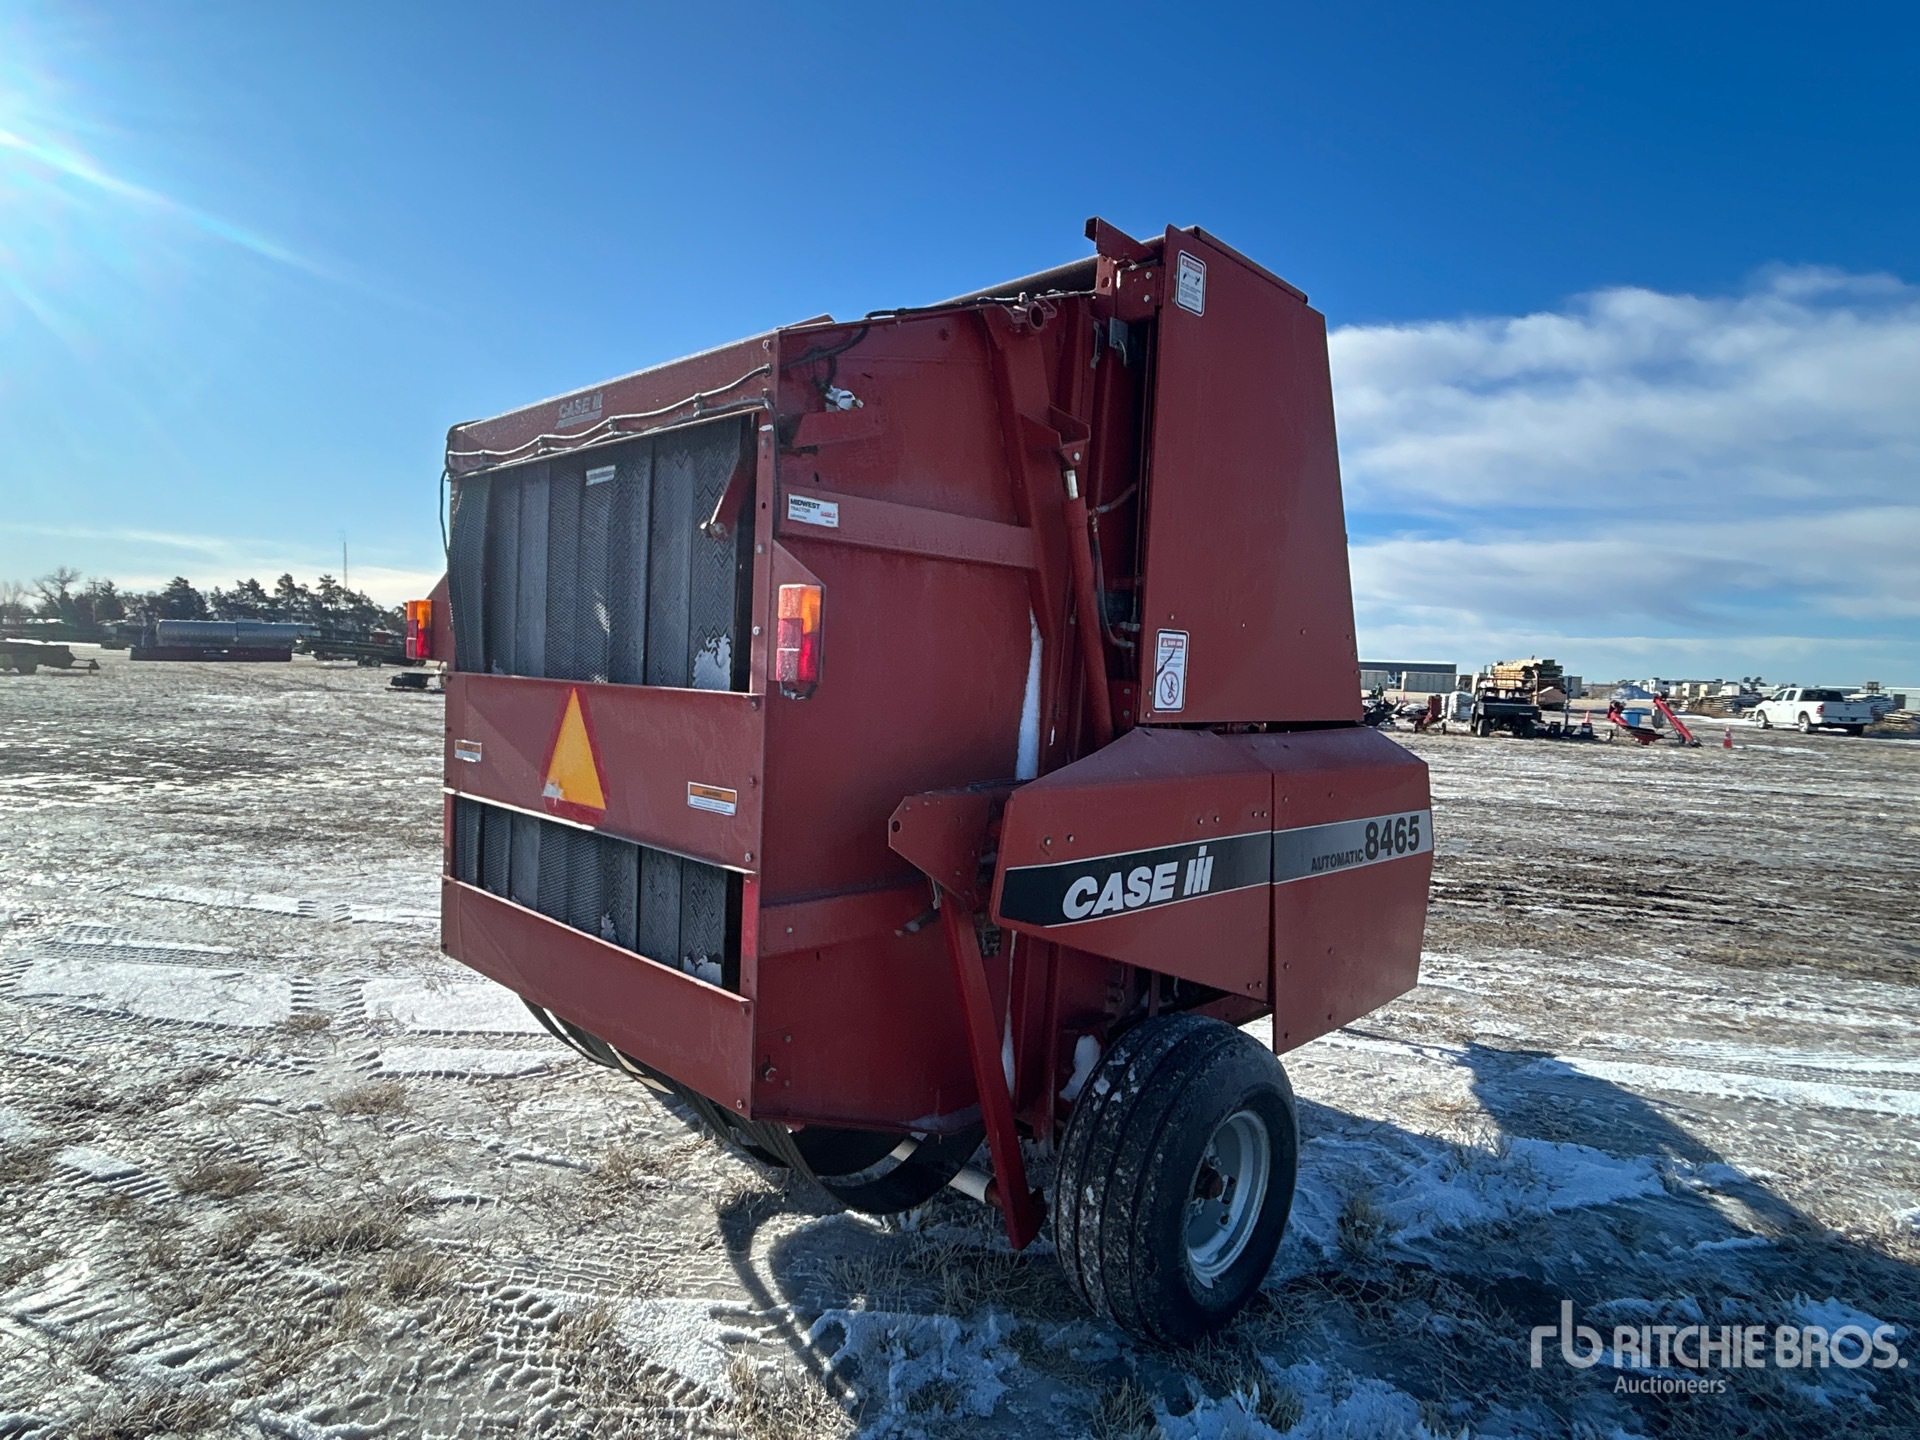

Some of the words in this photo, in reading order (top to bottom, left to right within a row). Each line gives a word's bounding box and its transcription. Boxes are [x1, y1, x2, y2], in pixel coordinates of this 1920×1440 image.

[559, 397, 590, 419] CASE
[790, 498, 821, 510] MIDWEST
[790, 505, 811, 514] TRACTOR
[1311, 848, 1364, 872] AUTOMATIC
[1365, 815, 1420, 860] 8465
[1062, 861, 1179, 920] CASE
